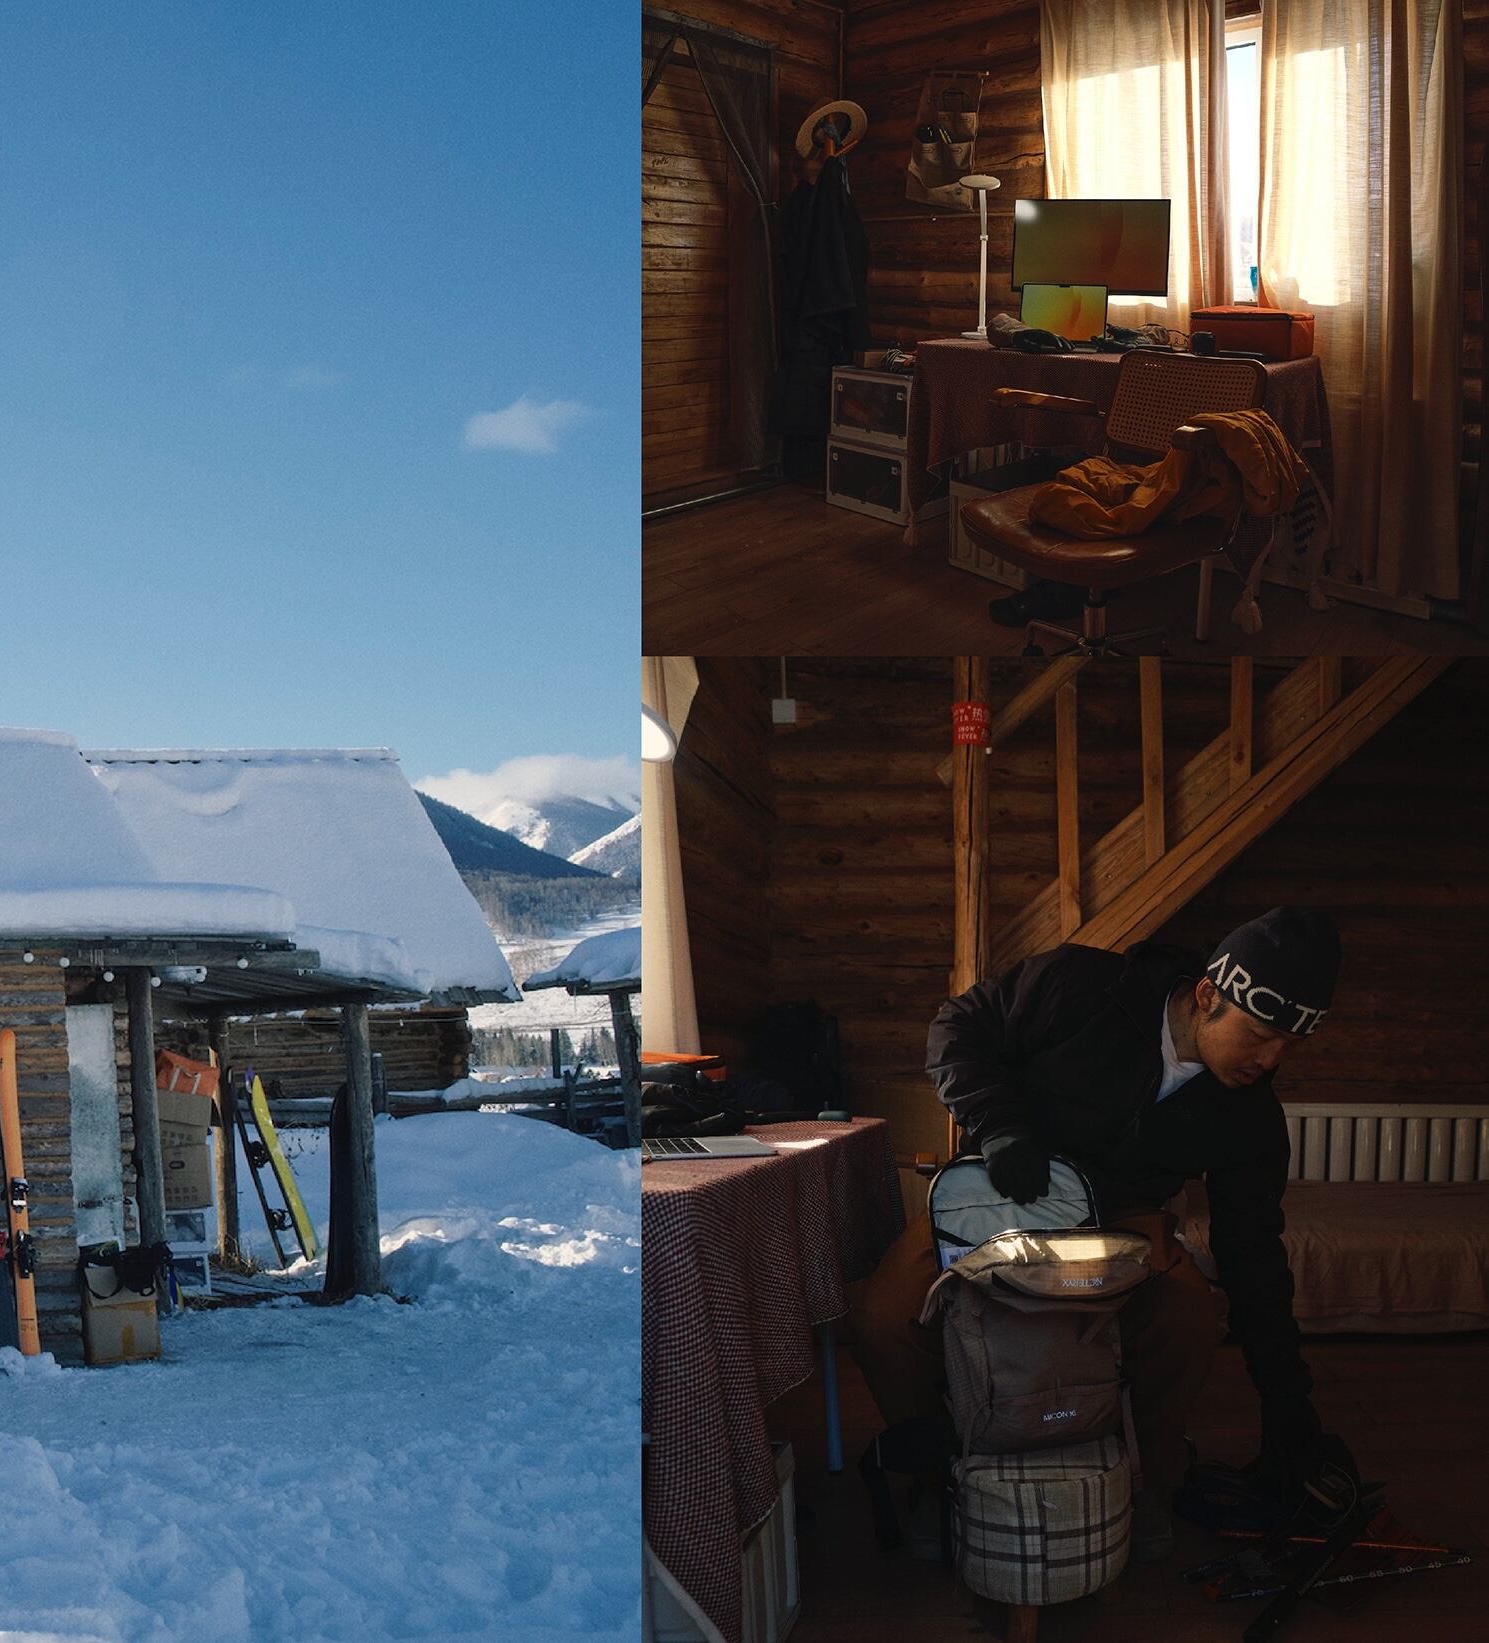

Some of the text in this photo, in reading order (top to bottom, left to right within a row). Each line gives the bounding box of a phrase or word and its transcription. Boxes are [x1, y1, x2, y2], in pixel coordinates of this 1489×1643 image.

[1339, 1574, 1354, 1583] 60
[1398, 1566, 1413, 1574] 50
[1428, 1561, 1442, 1569] 45
[1457, 1556, 1471, 1564] 40
